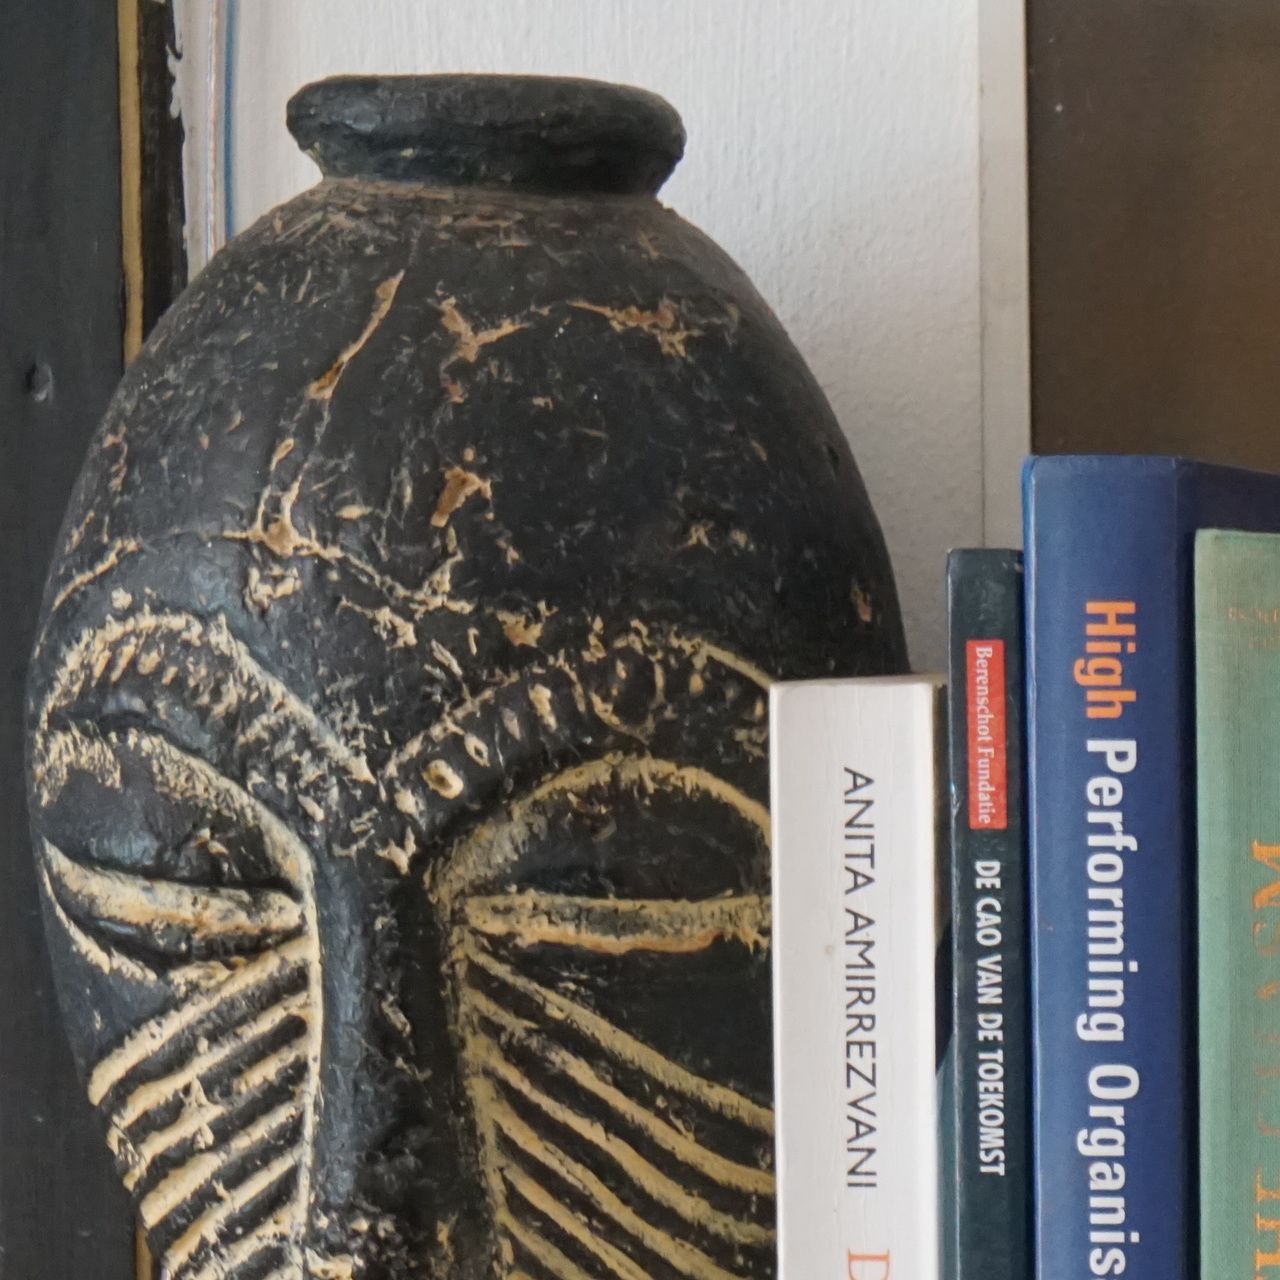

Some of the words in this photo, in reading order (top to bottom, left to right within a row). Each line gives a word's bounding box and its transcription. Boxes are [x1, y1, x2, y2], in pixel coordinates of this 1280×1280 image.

[975, 647, 994, 741] Berenschot
[1074, 601, 1136, 719] High
[844, 767, 876, 896] ANITA
[977, 748, 996, 824] Fundatie
[975, 860, 1000, 888] DE
[1076, 740, 1138, 1042] Performing
[975, 897, 1001, 947] CAO
[976, 956, 1002, 1003] VAN
[844, 908, 877, 1188] AMIRREZVANI
[977, 1014, 1003, 1041] DE
[978, 1049, 1005, 1176] TOEKOMST
